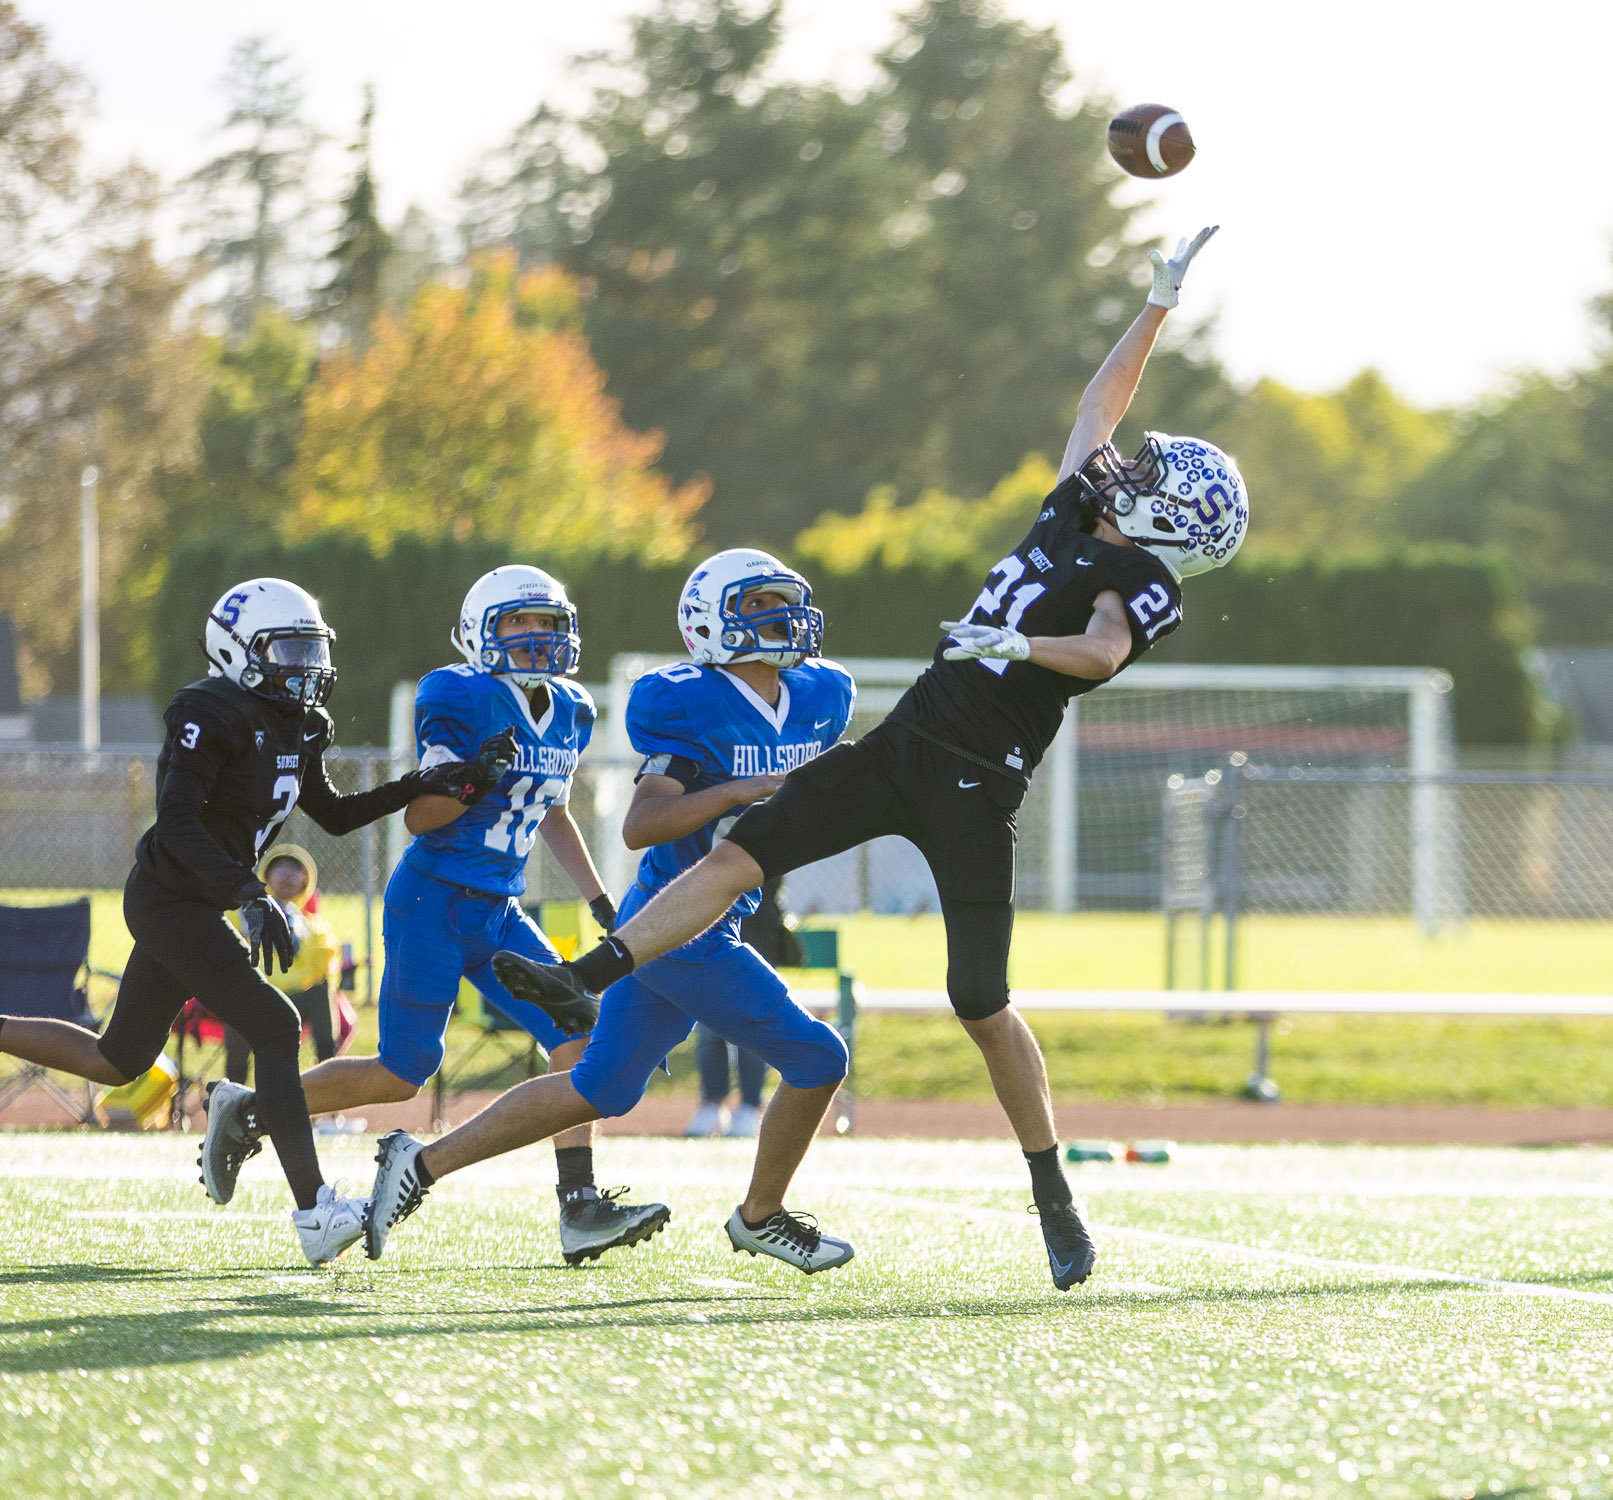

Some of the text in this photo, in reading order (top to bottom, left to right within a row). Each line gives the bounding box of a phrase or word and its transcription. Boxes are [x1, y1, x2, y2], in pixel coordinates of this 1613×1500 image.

[1191, 483, 1234, 525] S
[1028, 547, 1054, 573] SUNSET
[219, 593, 249, 627] S
[948, 553, 1049, 678] 21
[1128, 582, 1182, 641] 21
[180, 722, 200, 750] 3
[276, 754, 299, 769] SUNSET
[506, 744, 579, 777] ILLSBORO
[484, 775, 565, 858] 16
